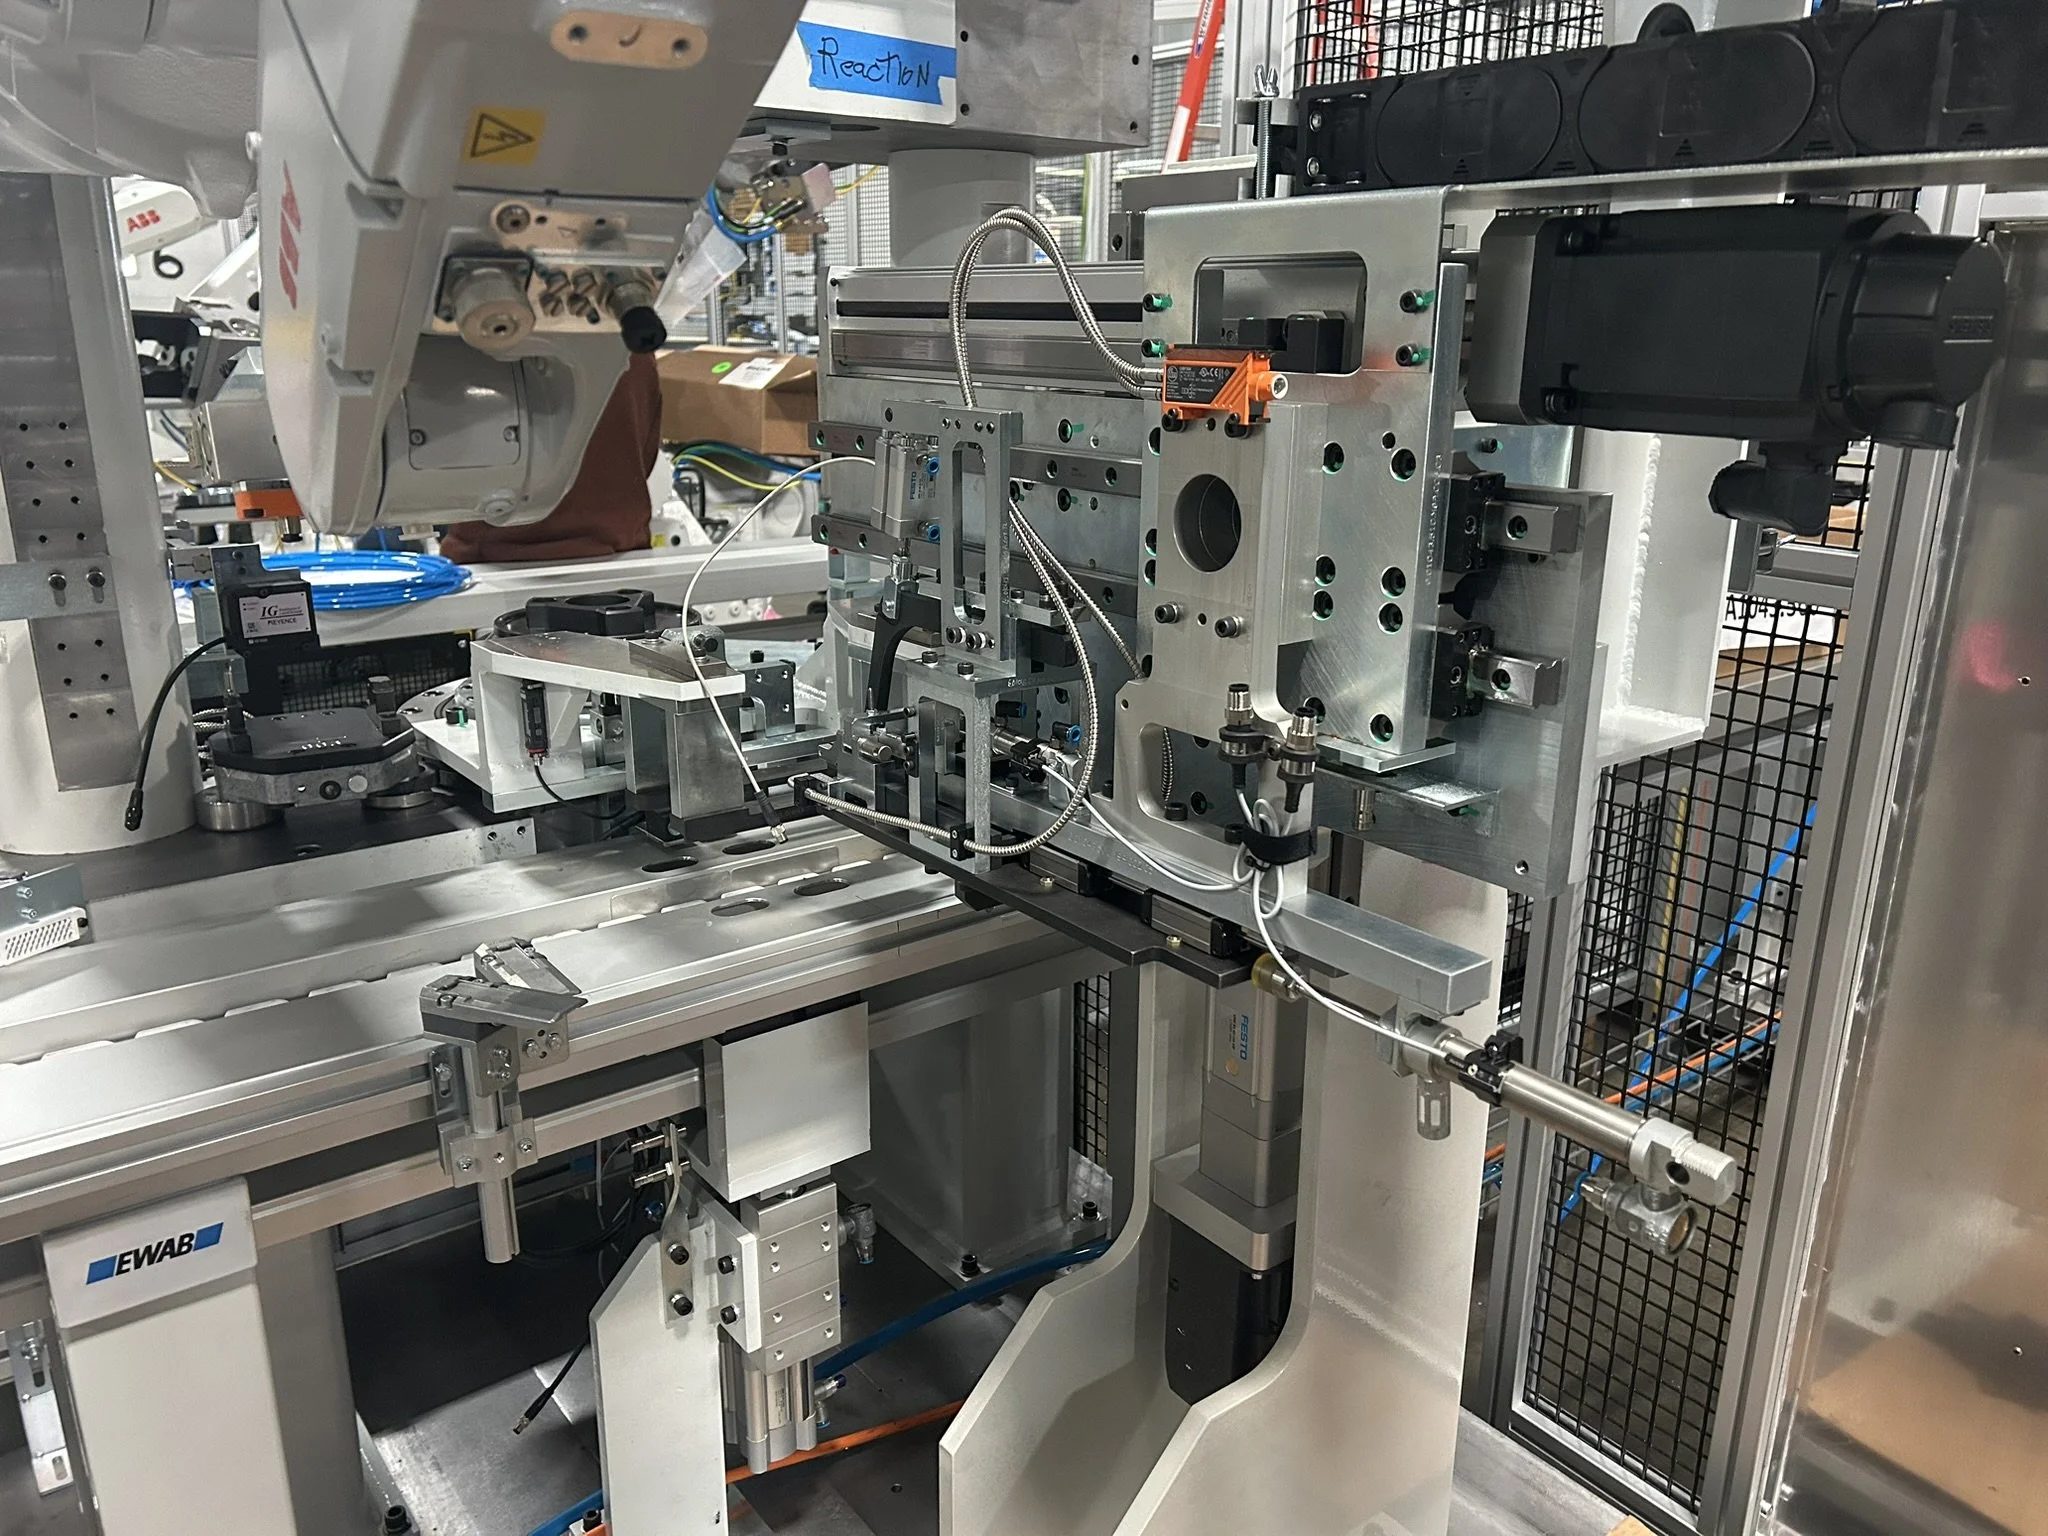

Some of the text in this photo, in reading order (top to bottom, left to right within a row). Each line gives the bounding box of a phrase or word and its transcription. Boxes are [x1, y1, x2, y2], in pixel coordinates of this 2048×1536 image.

[127, 209, 161, 233] ABB
[153, 248, 184, 279] 6
[909, 471, 917, 500] FESTO
[261, 605, 278, 617] IG
[267, 617, 297, 626] KEYENCE
[1240, 1014, 1249, 1060] FESTO
[115, 1233, 195, 1276] EWAB
